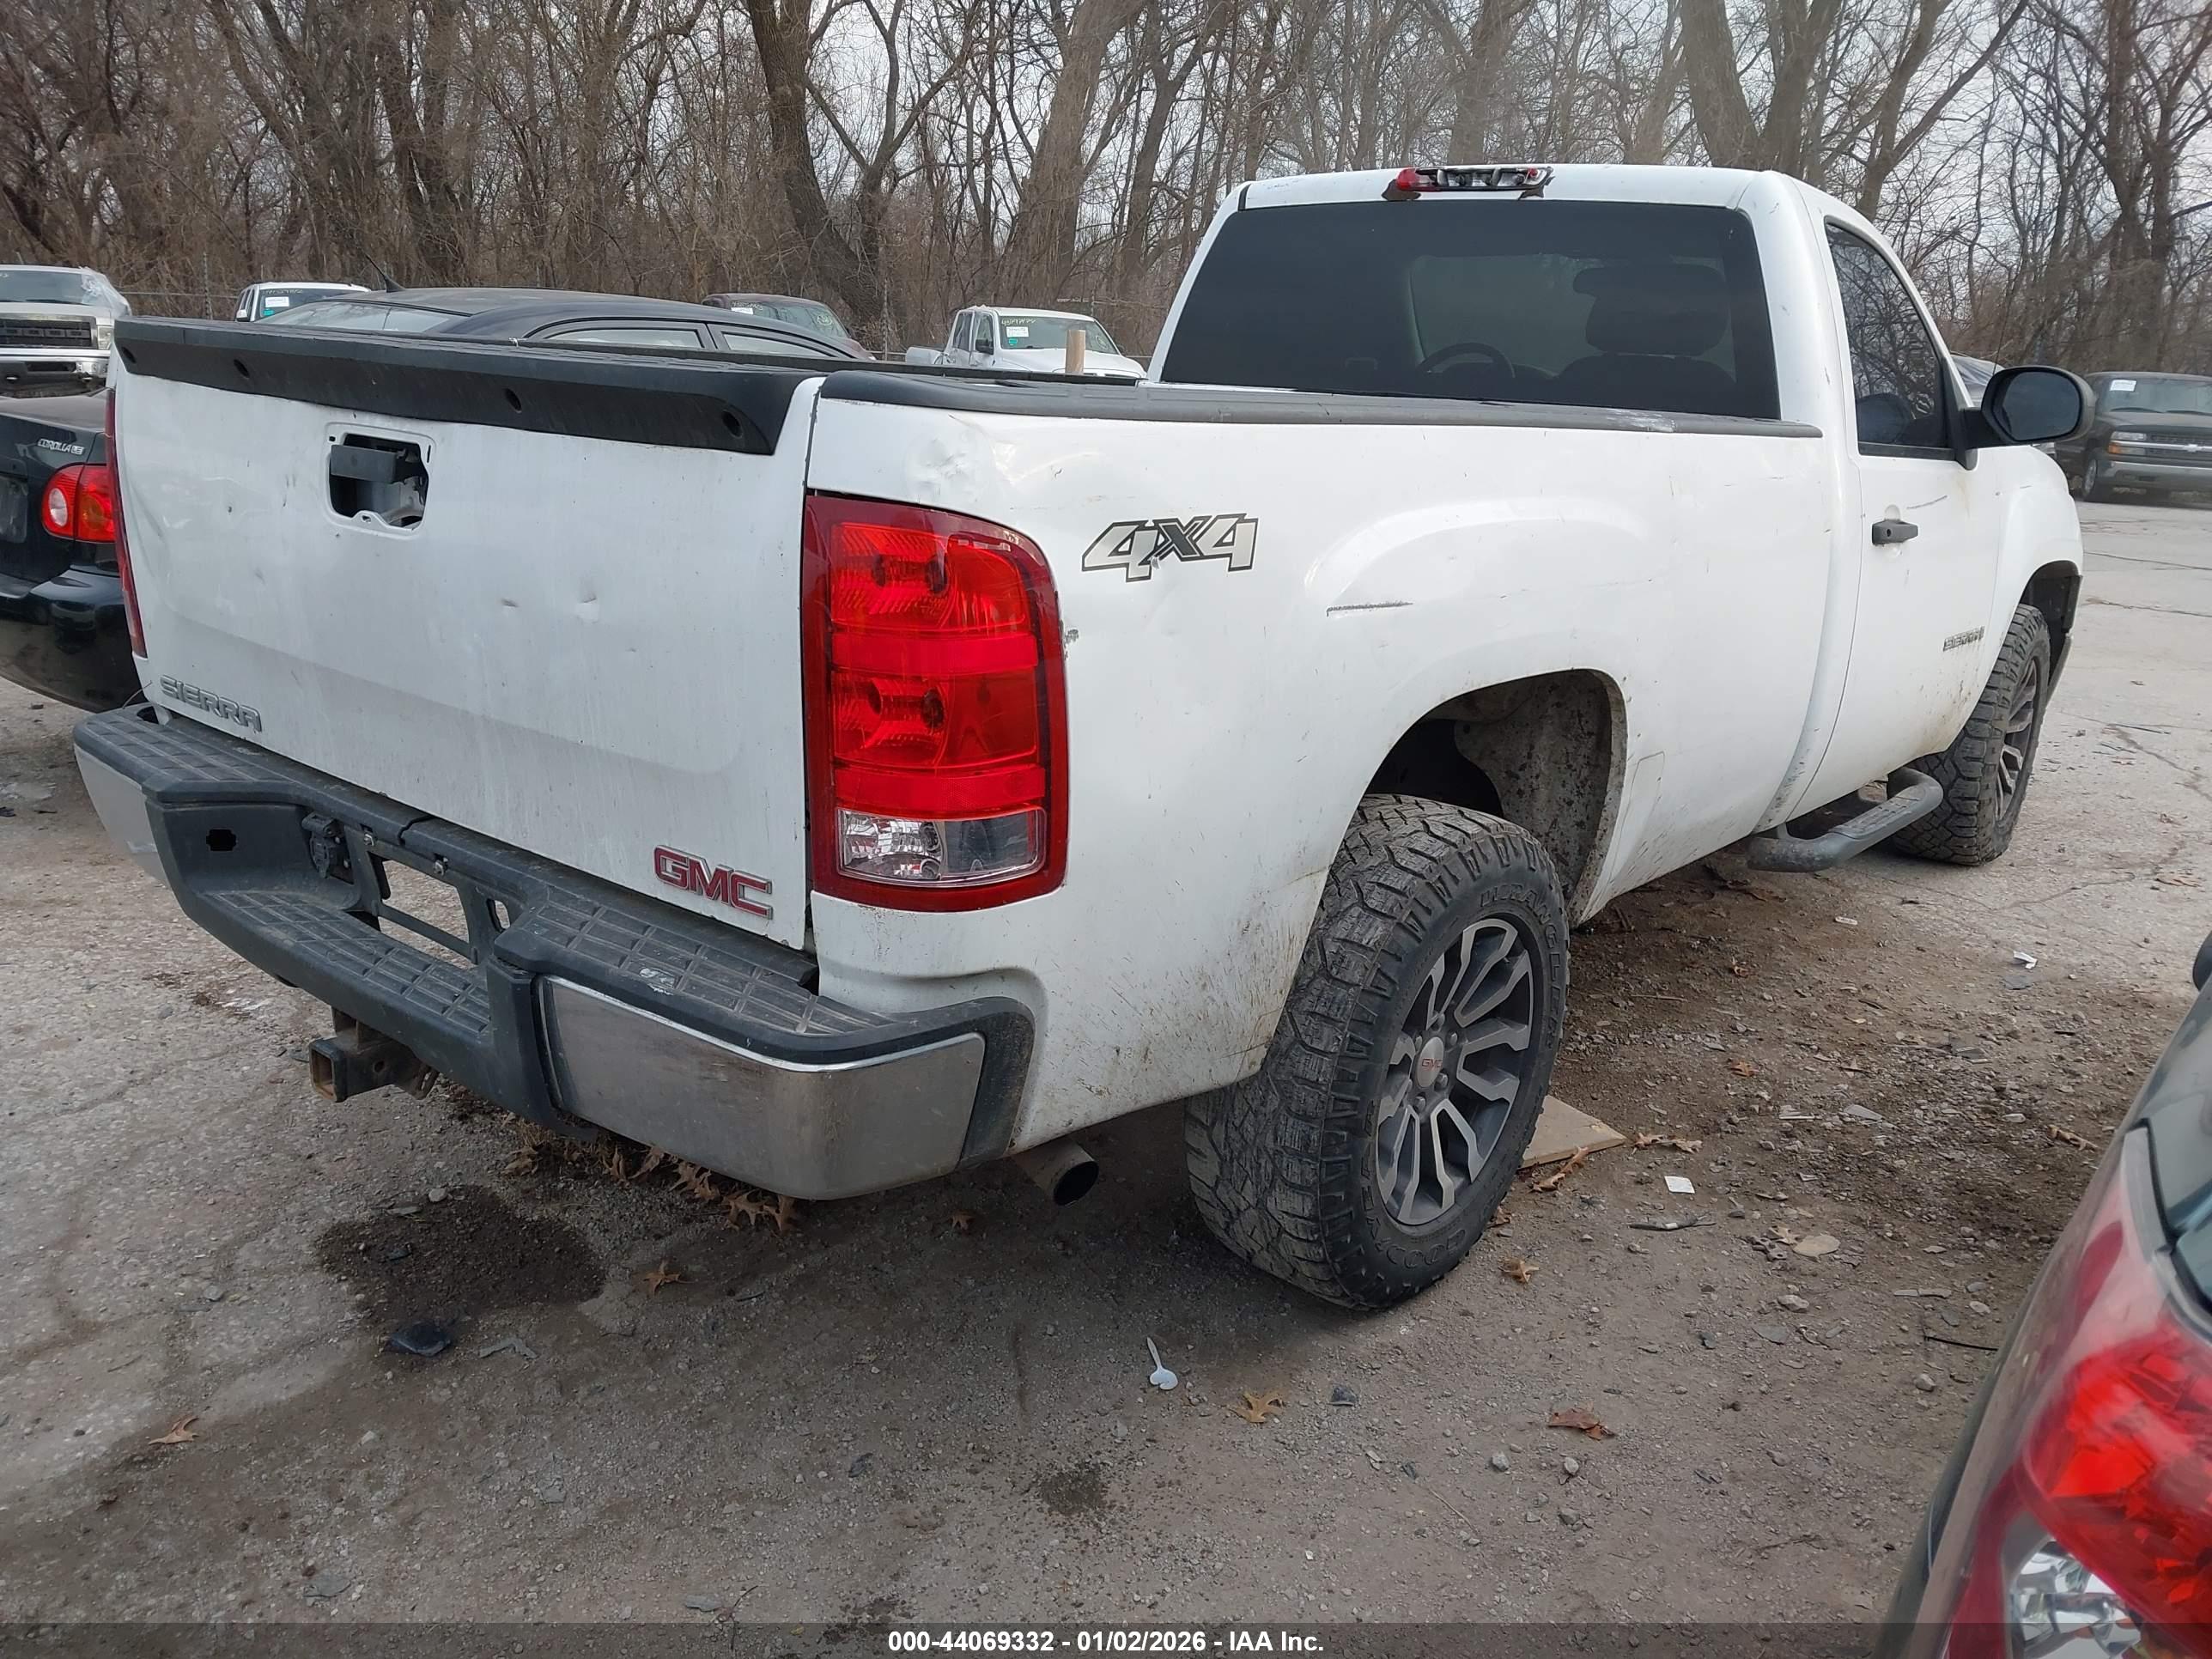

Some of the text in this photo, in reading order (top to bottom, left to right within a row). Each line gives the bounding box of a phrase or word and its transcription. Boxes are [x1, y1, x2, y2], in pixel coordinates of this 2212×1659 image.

[38, 439, 84, 455] COROLLA LE
[160, 674, 262, 732] SIERRA
[653, 844, 773, 920] GMC
[1421, 1058, 1443, 1067] GMC
